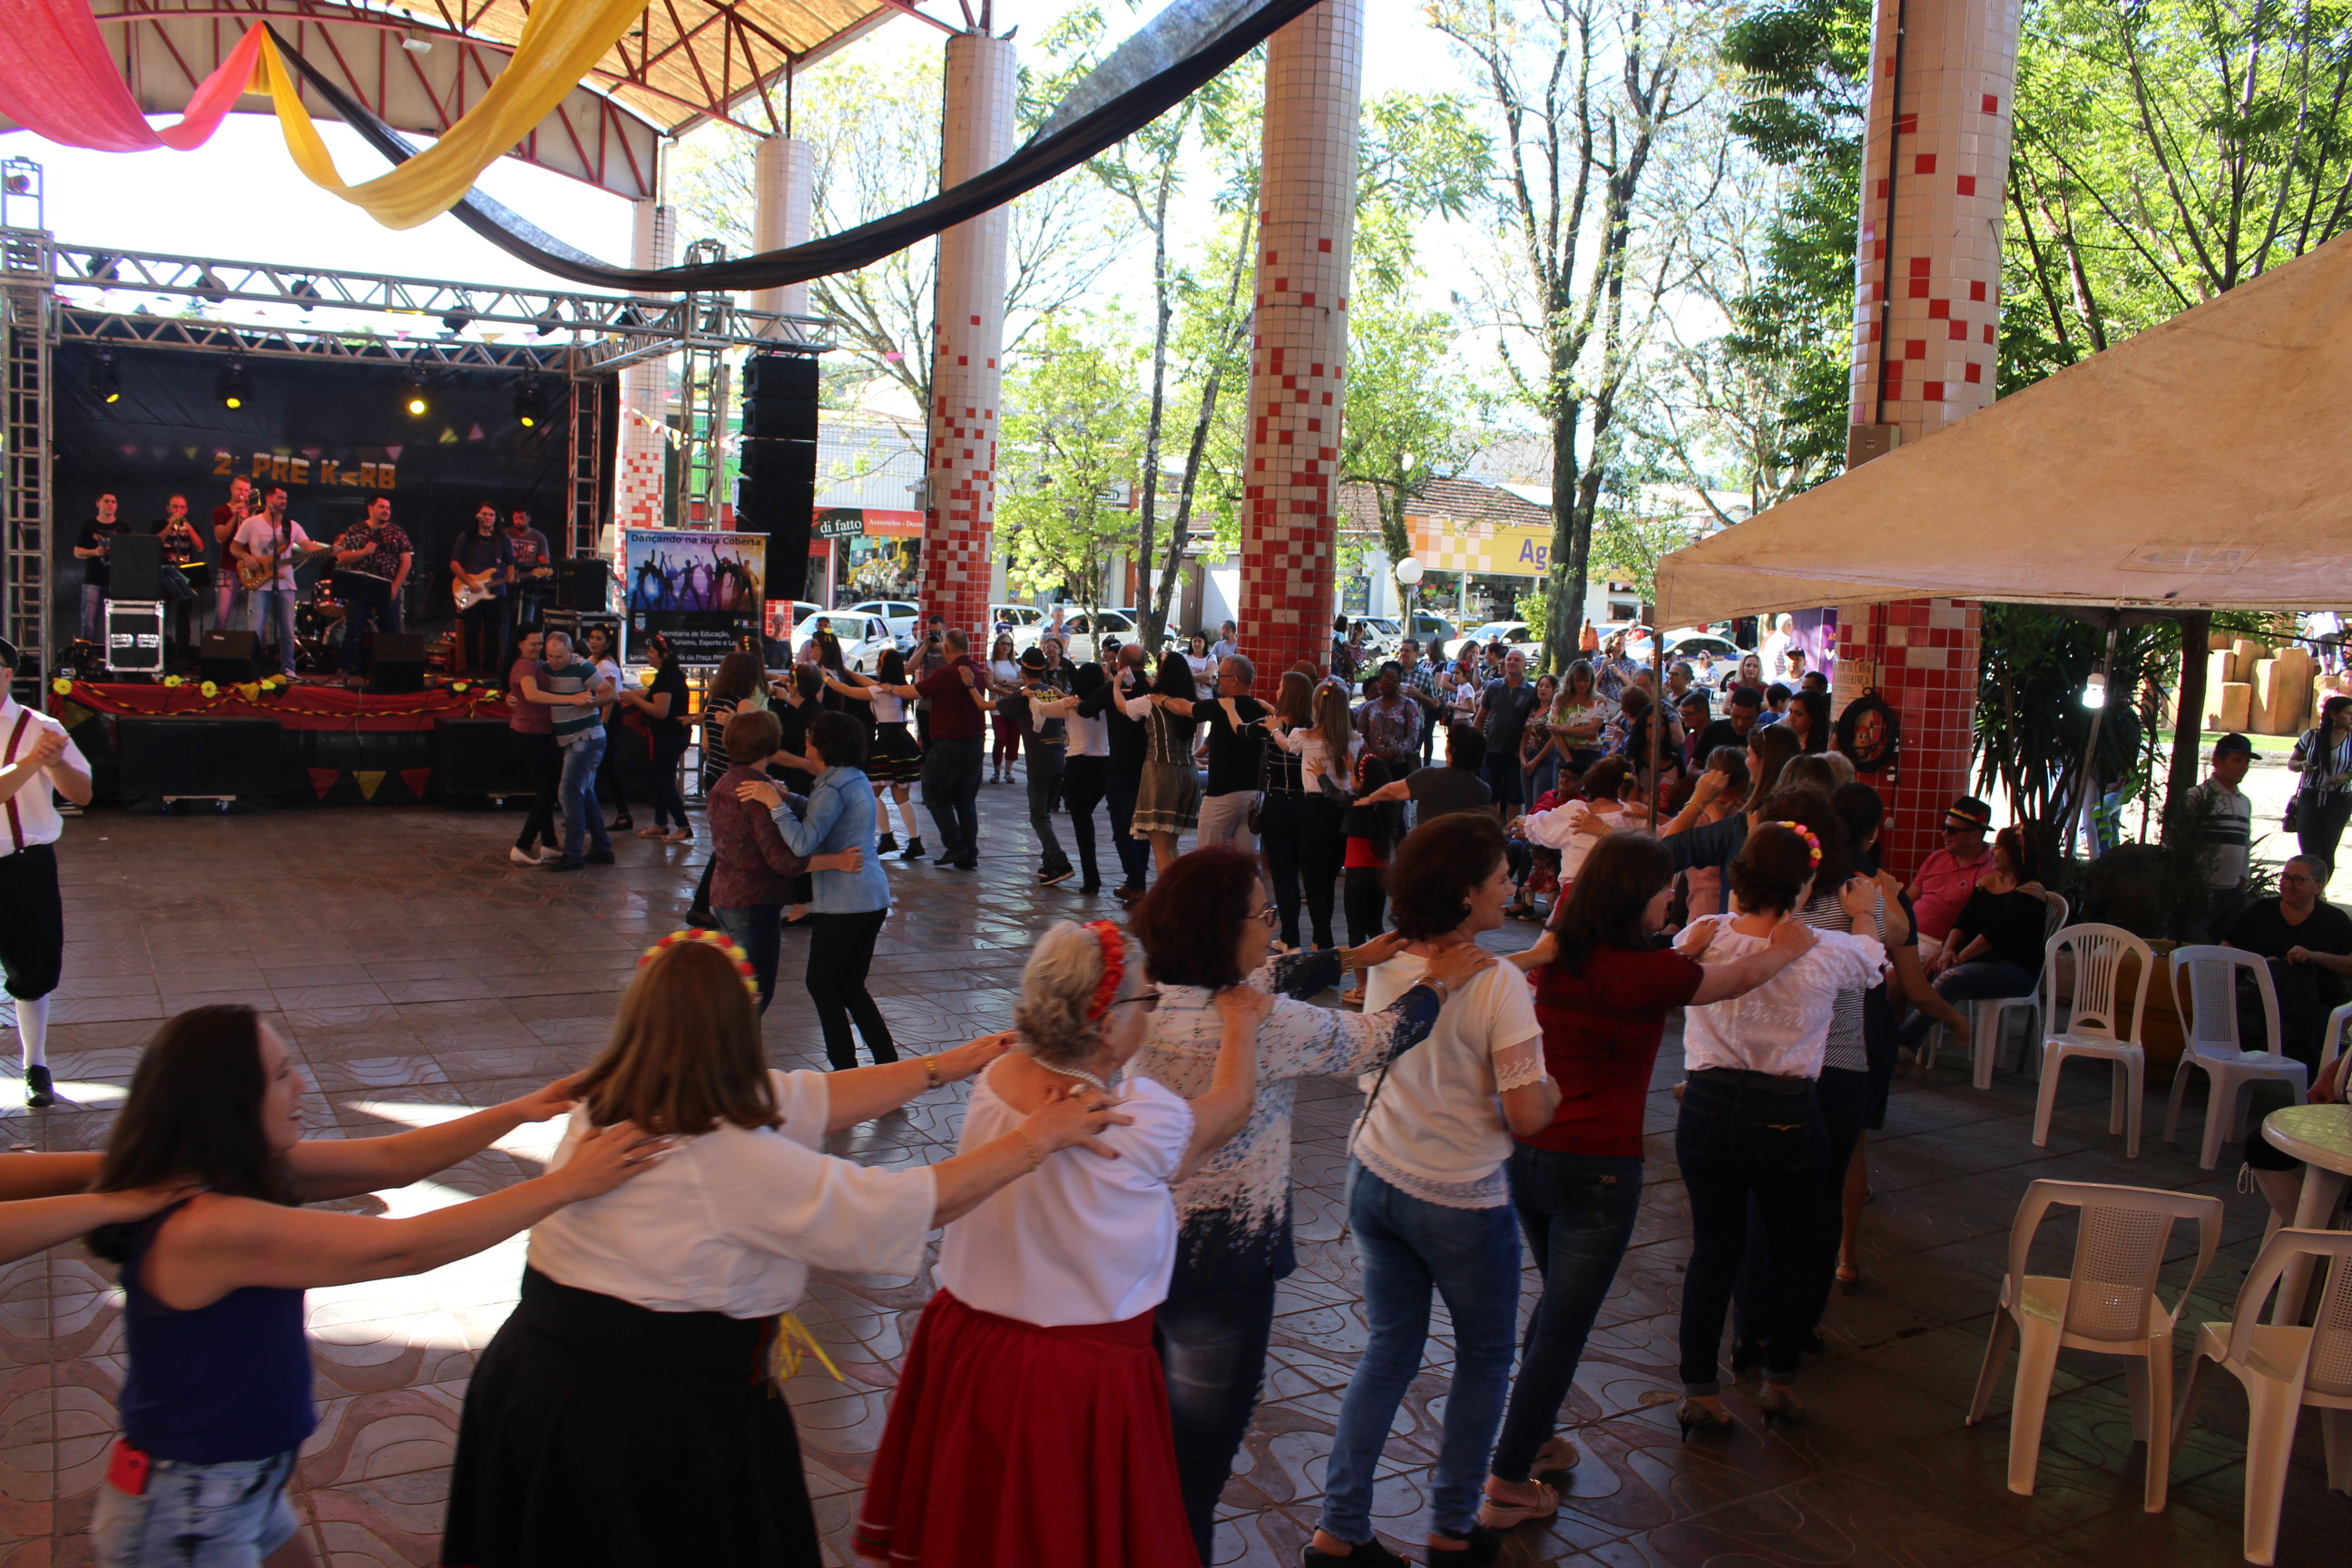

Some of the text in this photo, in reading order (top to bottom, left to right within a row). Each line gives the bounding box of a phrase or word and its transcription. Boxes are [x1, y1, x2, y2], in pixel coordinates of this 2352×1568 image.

[820, 521, 832, 534] di
[835, 519, 862, 532] fatto
[631, 534, 681, 544] Dançando
[722, 536, 760, 545] Coberta
[700, 639, 721, 647] Esporte
